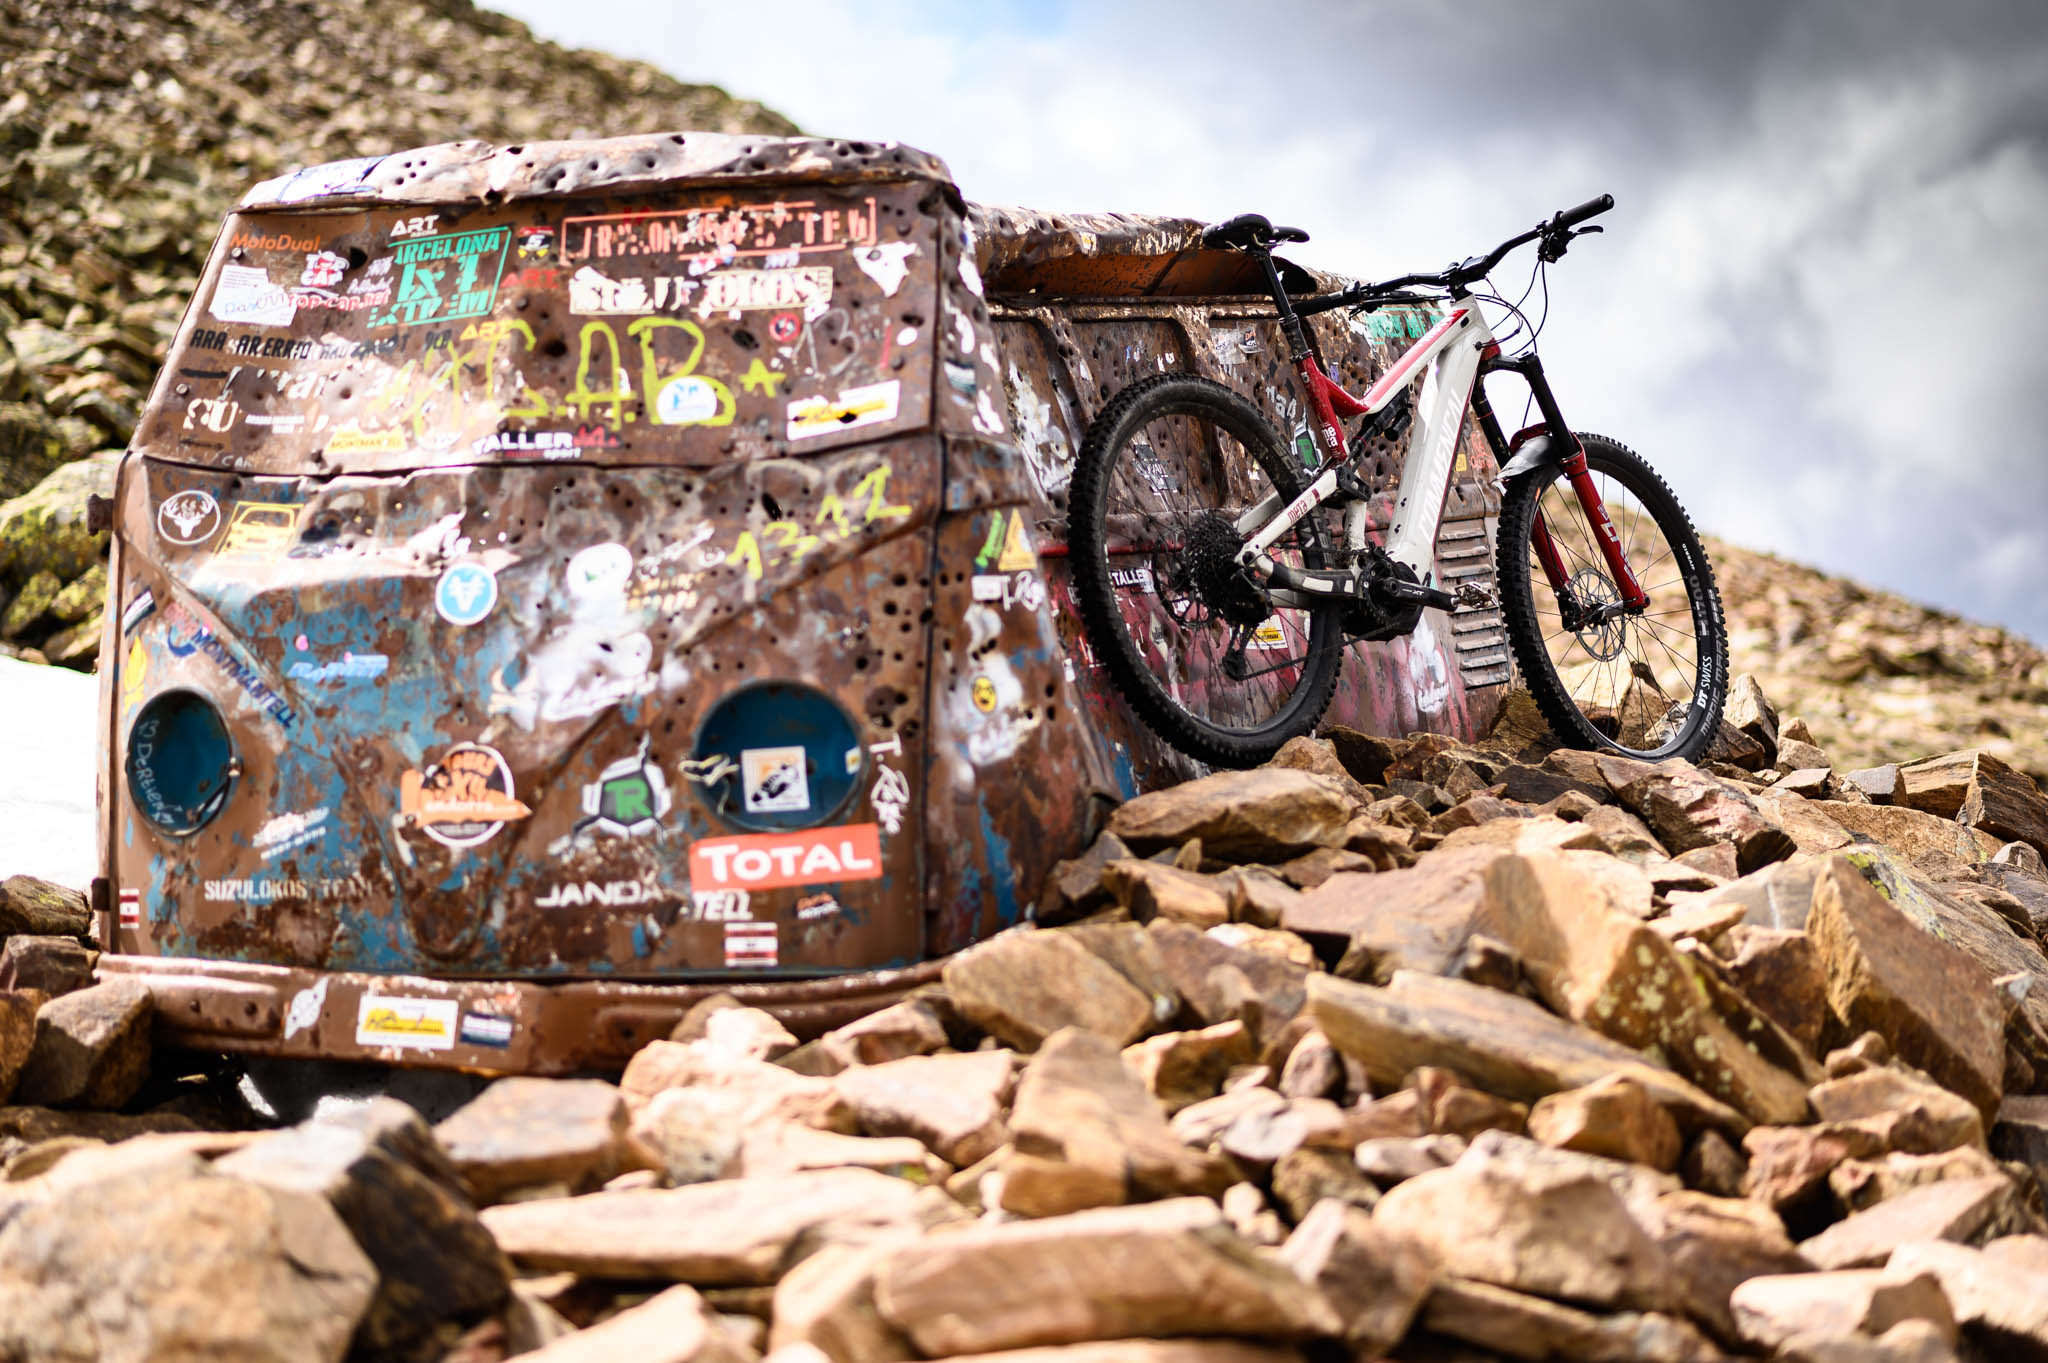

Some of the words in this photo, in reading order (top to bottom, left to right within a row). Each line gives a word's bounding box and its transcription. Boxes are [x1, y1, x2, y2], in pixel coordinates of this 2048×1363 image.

[390, 215, 440, 237] ART
[230, 232, 320, 252] MotoDual
[472, 431, 573, 455] TALLER
[1111, 569, 1152, 586] TALLE
[1700, 687, 1721, 737] MAGIC
[1714, 626, 1724, 684] MARY
[1701, 656, 1713, 690] SWISS
[1697, 690, 1709, 710] DT
[698, 841, 873, 883] TOTAL
[204, 879, 308, 901] SUZULOKOS
